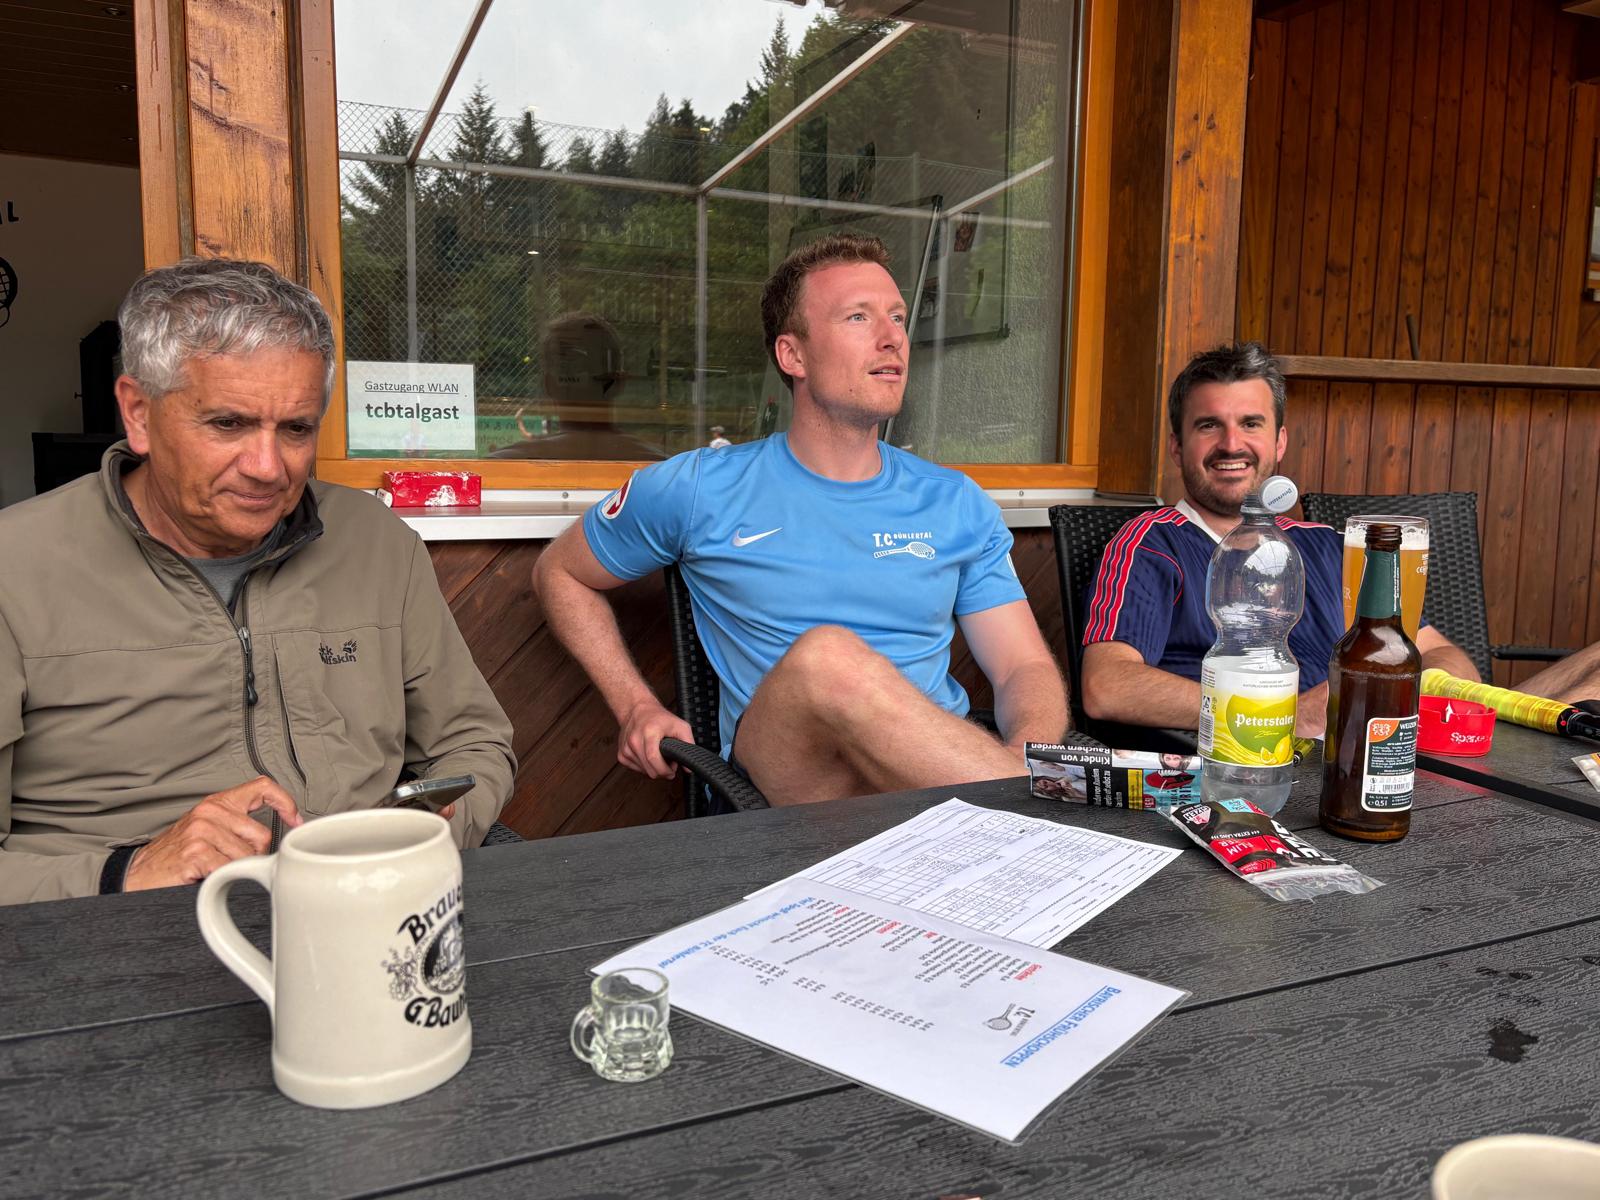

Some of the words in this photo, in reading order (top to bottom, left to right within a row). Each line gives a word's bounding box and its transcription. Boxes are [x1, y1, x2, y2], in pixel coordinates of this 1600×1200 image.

[365, 381, 425, 393] Gastzugang
[428, 382, 459, 393] WLAN
[365, 402, 460, 423] tcbtalgast
[893, 531, 933, 540] BÜHLERTAL
[1234, 713, 1294, 728] Peterstaler
[1031, 742, 1067, 752] werden
[1067, 746, 1111, 754] Rauchern
[1061, 753, 1079, 762] von
[1079, 754, 1111, 765] Kinder
[1066, 986, 1121, 1021] BAYRISCHER
[1001, 1019, 1077, 1067] FRÜHSCHOPPEN
